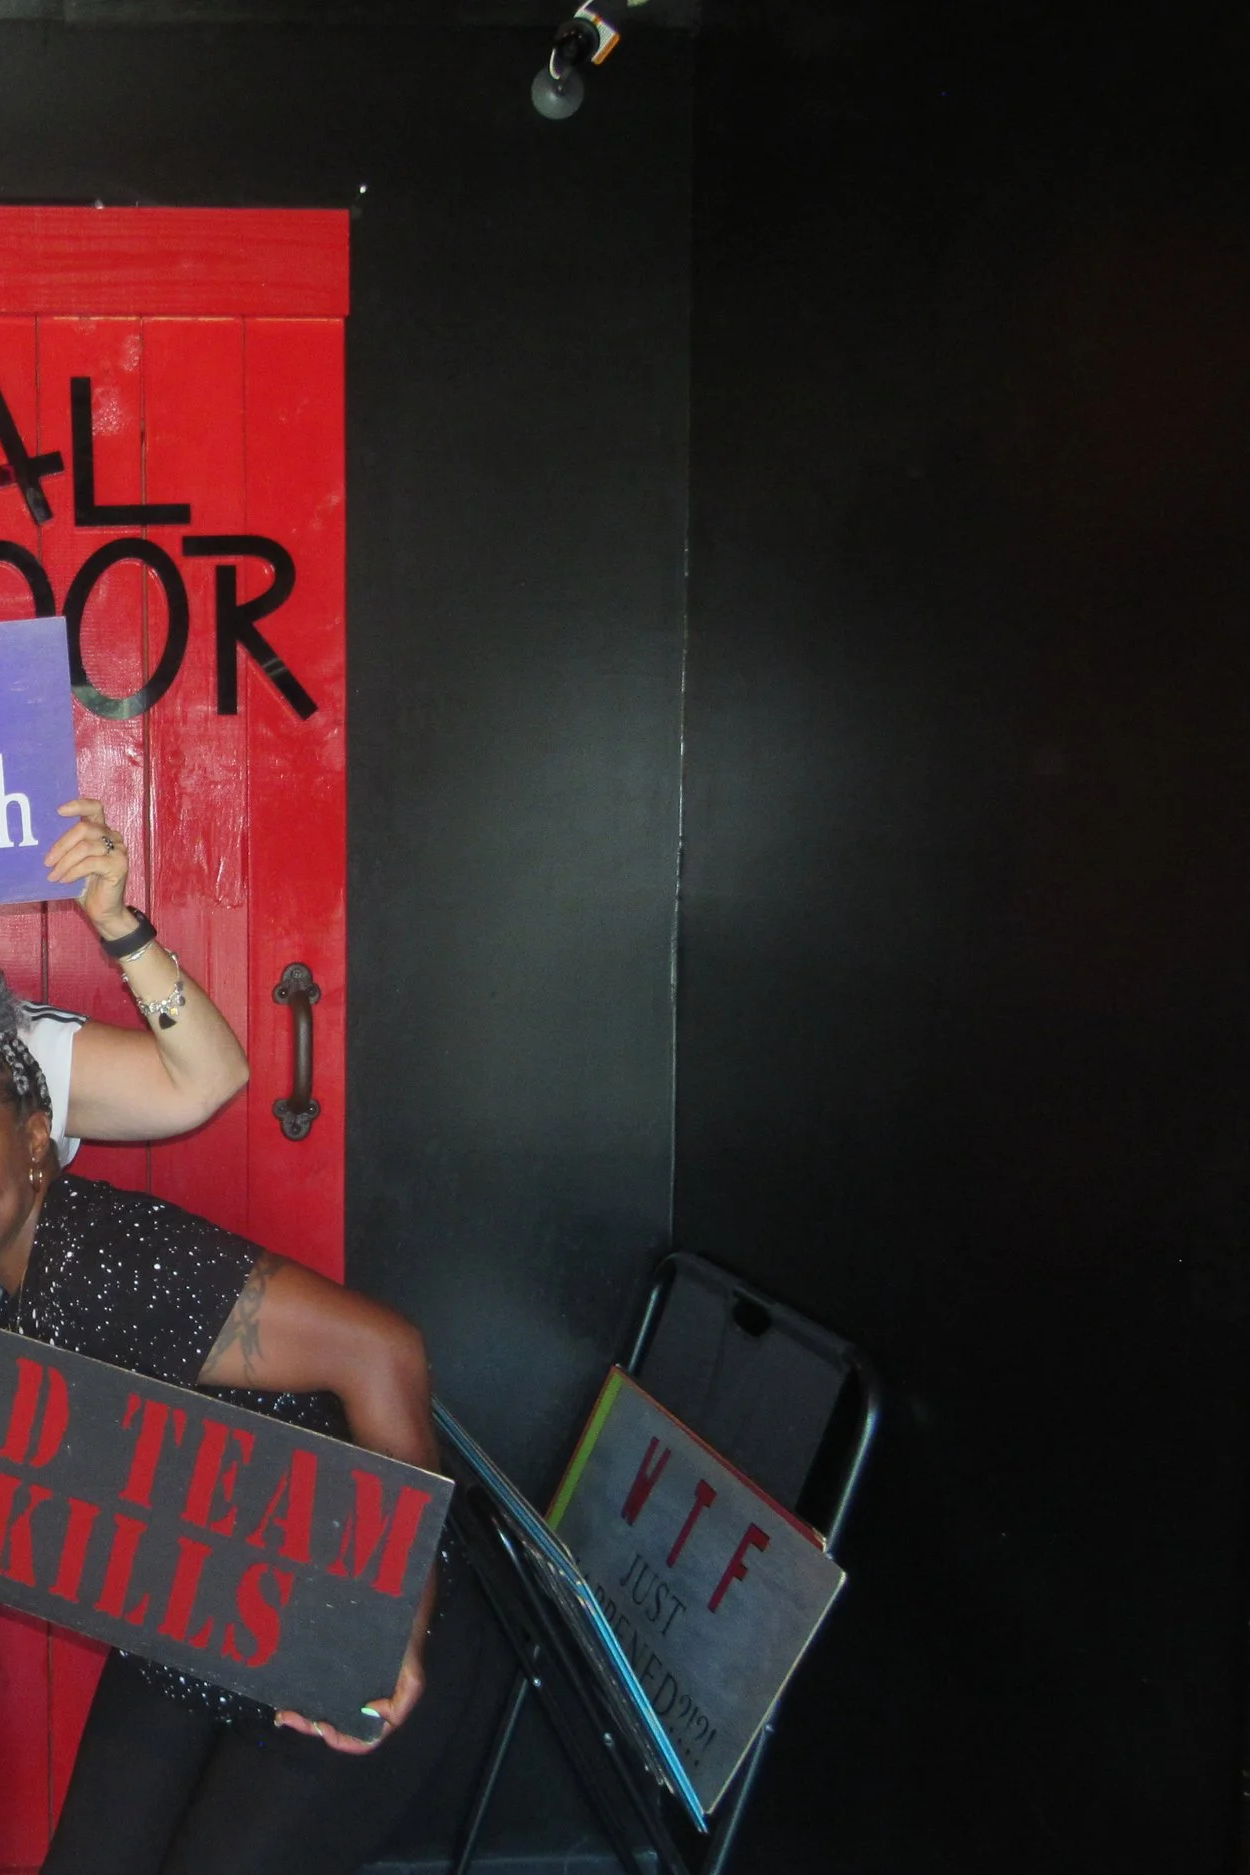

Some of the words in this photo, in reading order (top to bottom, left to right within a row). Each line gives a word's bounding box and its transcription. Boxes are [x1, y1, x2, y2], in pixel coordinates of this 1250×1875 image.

[119, 1392, 432, 1598] TEAM
[621, 1436, 770, 1614] WTF
[619, 1553, 687, 1636] JUST
